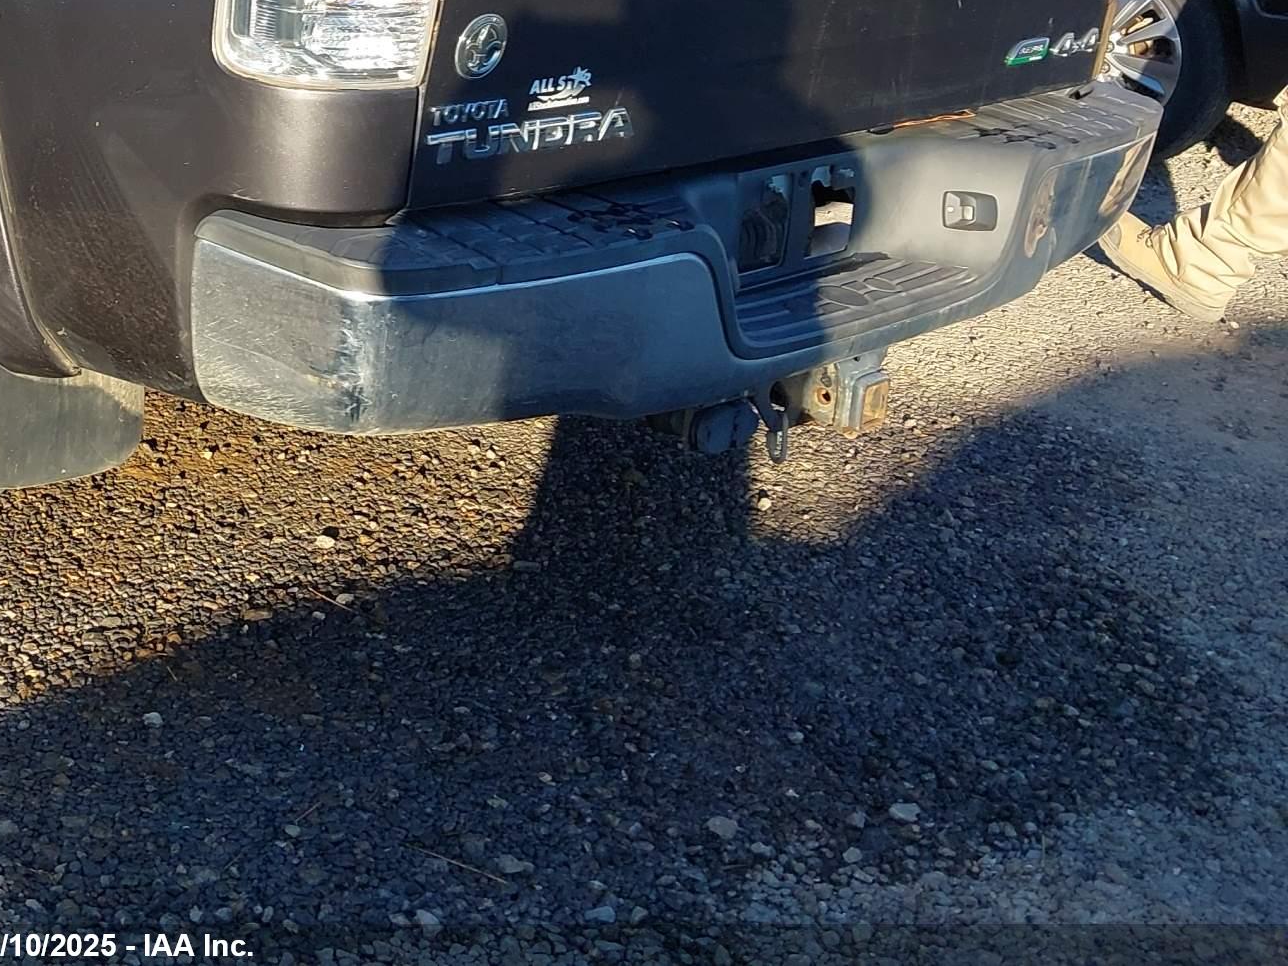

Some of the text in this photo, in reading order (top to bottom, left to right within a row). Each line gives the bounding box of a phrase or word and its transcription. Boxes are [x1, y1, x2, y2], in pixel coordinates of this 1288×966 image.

[529, 77, 555, 95] ALL
[430, 99, 510, 126] TOYOTA
[426, 107, 634, 164] TUNDRA
